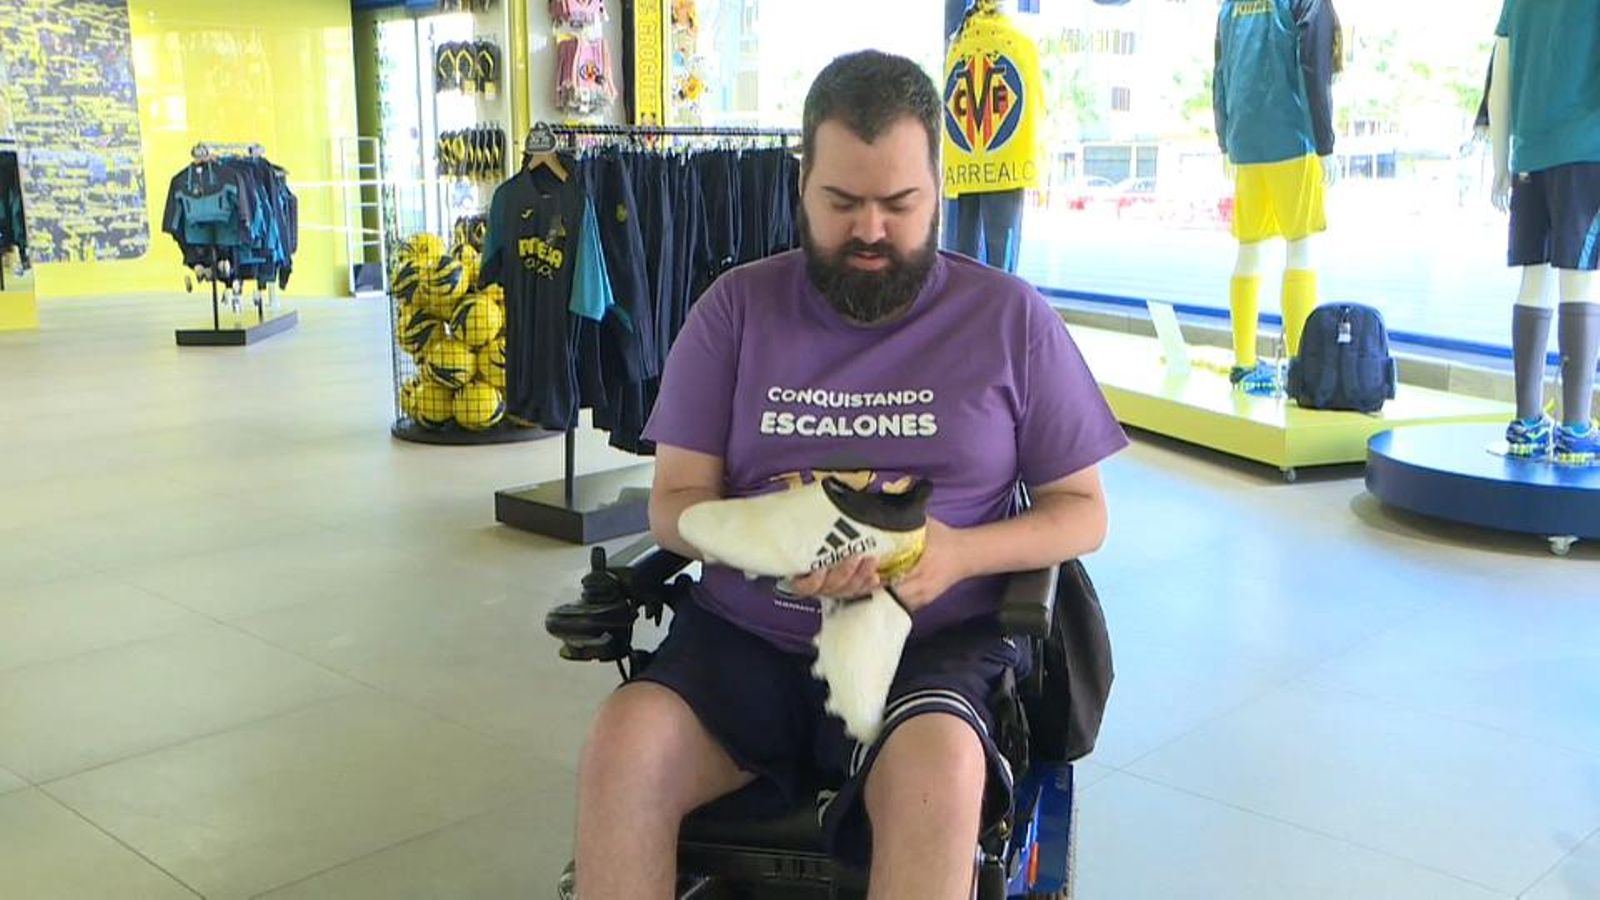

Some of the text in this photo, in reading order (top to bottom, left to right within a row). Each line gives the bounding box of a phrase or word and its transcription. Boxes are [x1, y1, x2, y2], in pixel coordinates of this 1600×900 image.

[767, 386, 934, 409] CONQUISTANDO
[760, 411, 938, 437] ESCALONES
[810, 535, 877, 572] adidas
